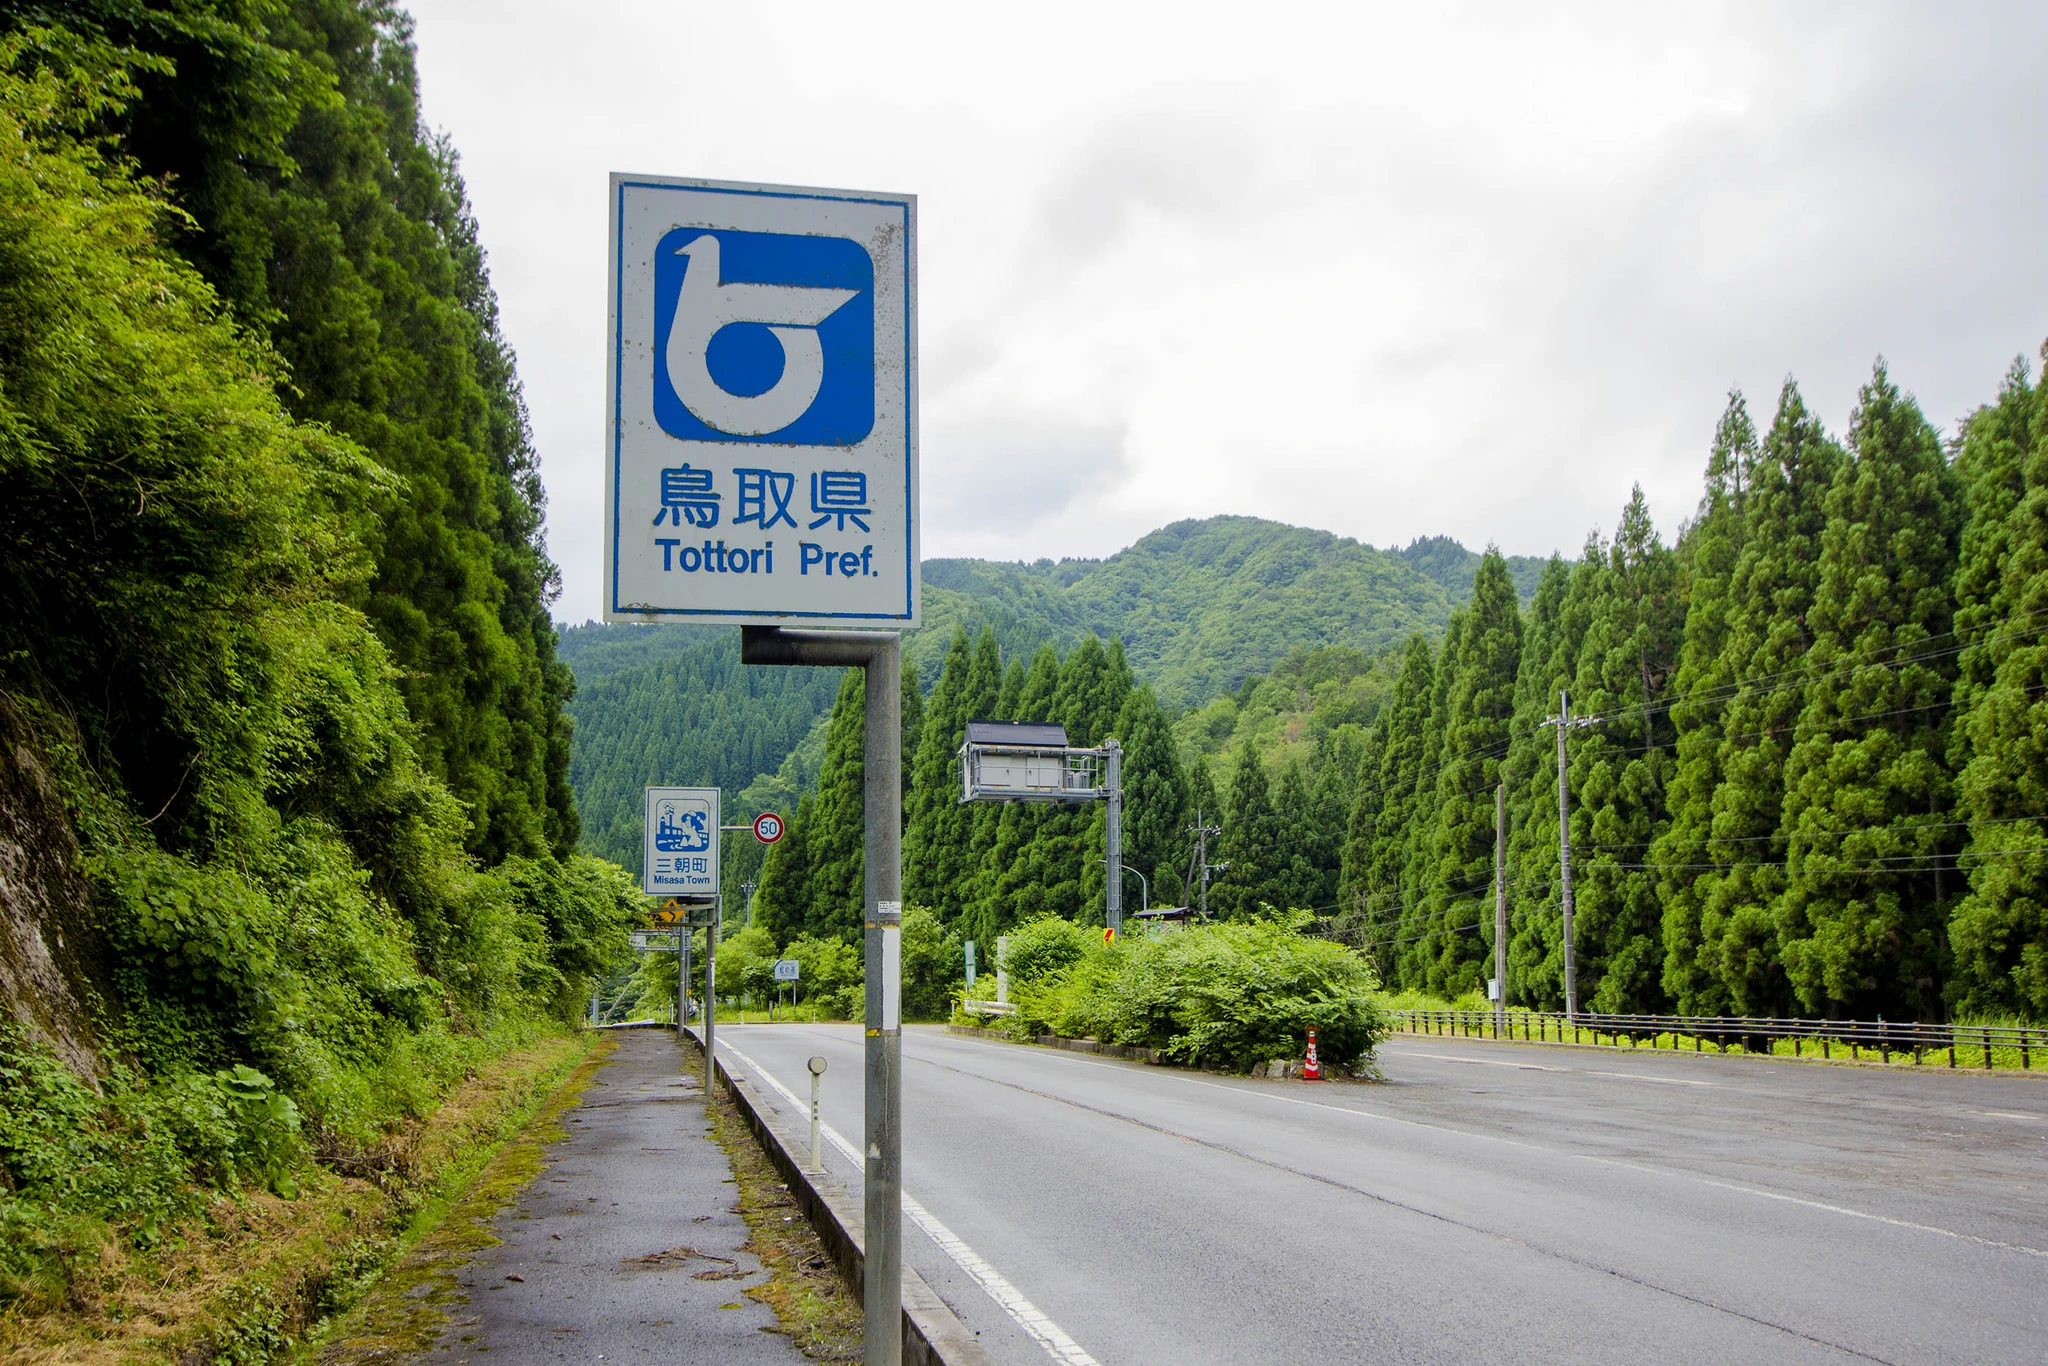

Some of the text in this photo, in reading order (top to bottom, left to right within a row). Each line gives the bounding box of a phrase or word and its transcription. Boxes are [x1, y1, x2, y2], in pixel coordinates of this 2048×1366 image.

[653, 463, 872, 533] 鳥取県
[654, 538, 878, 577] Tottori Pref.
[760, 821, 777, 835] 50
[655, 857, 708, 873] 三朝町
[653, 875, 710, 884] Misasa Town
